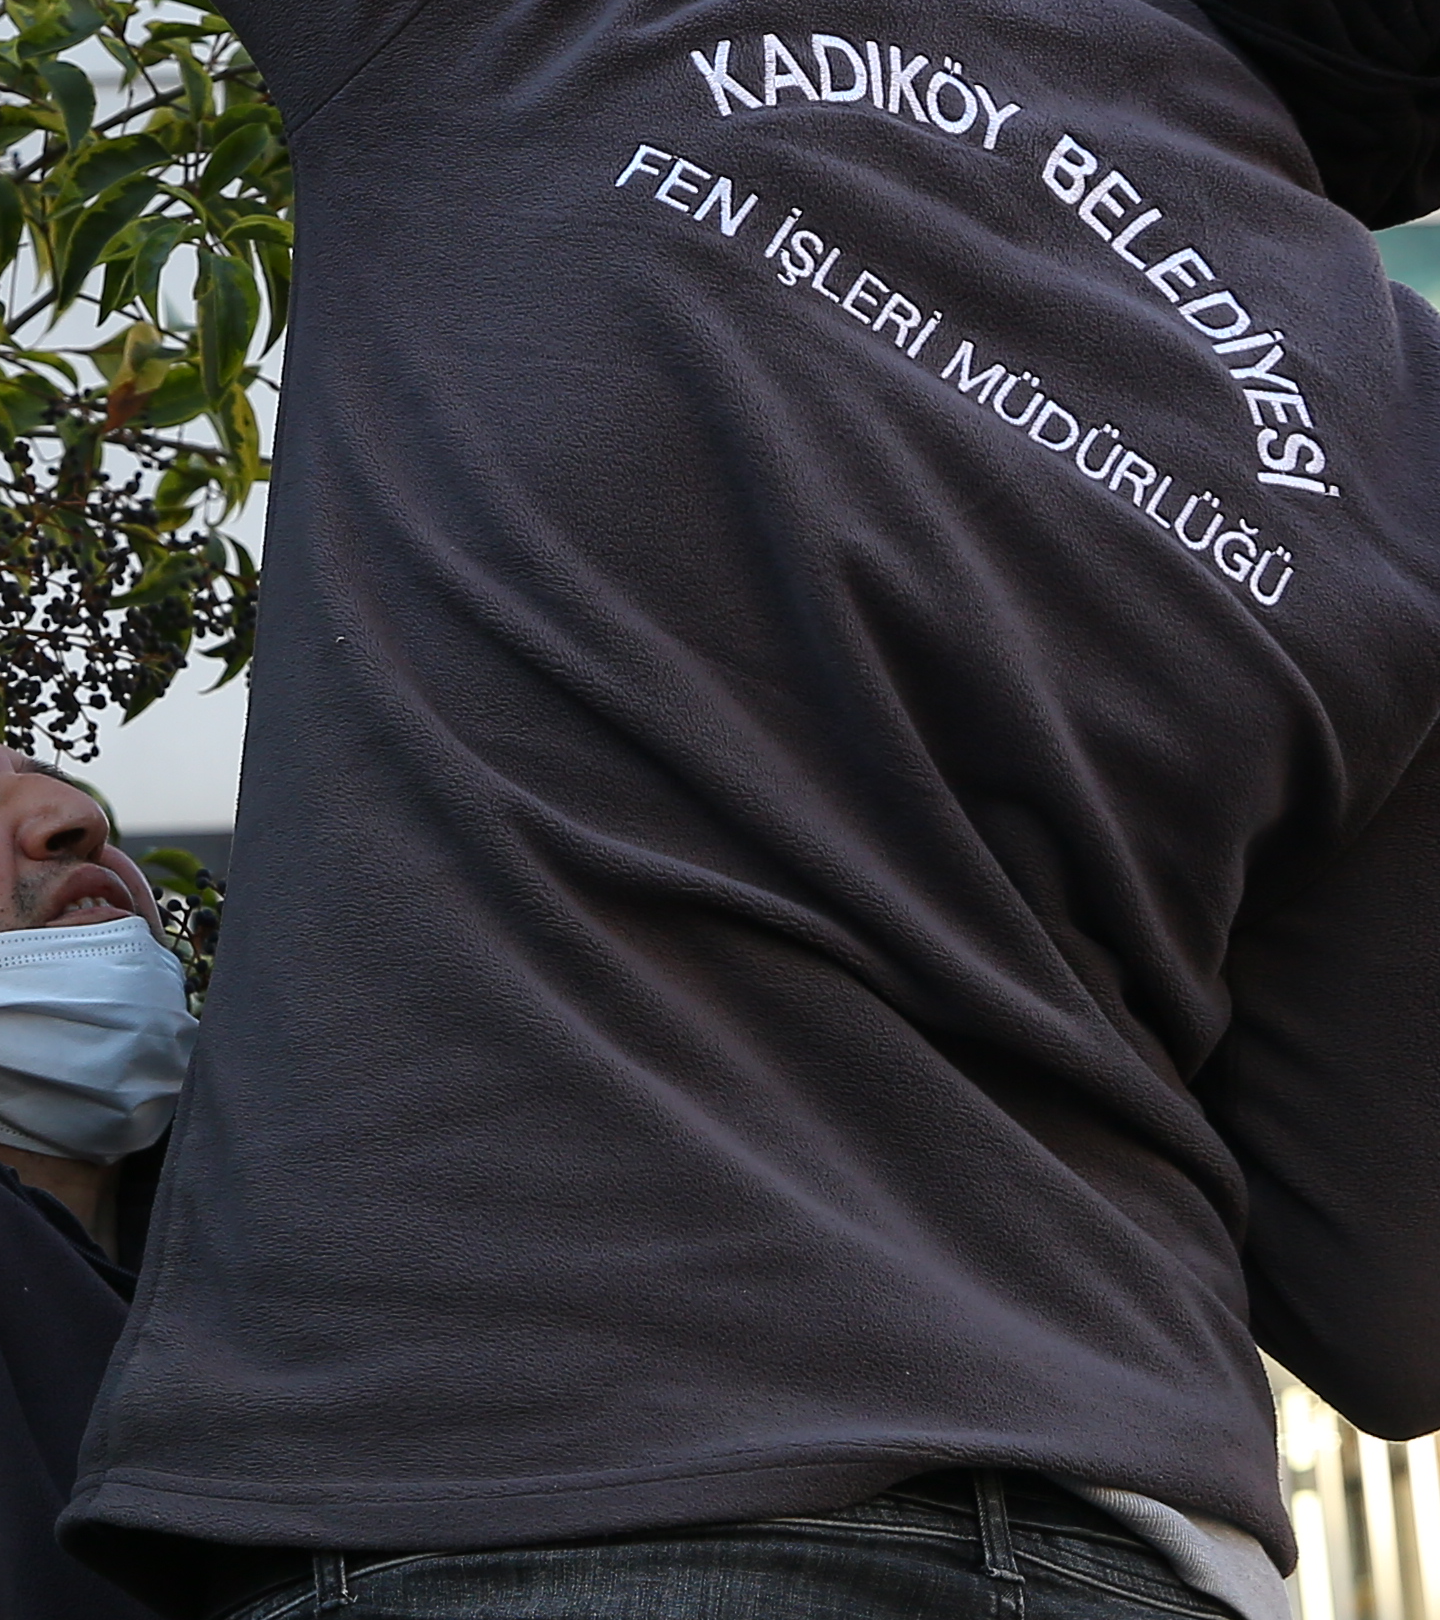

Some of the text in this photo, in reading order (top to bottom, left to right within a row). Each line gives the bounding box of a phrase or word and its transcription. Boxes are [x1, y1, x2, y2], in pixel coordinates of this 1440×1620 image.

[614, 144, 1295, 608] FEN İŞLERİ MÜDÜRLÜĞÜ
[689, 33, 1342, 498] KADIKÖY BELEDİYESİ
